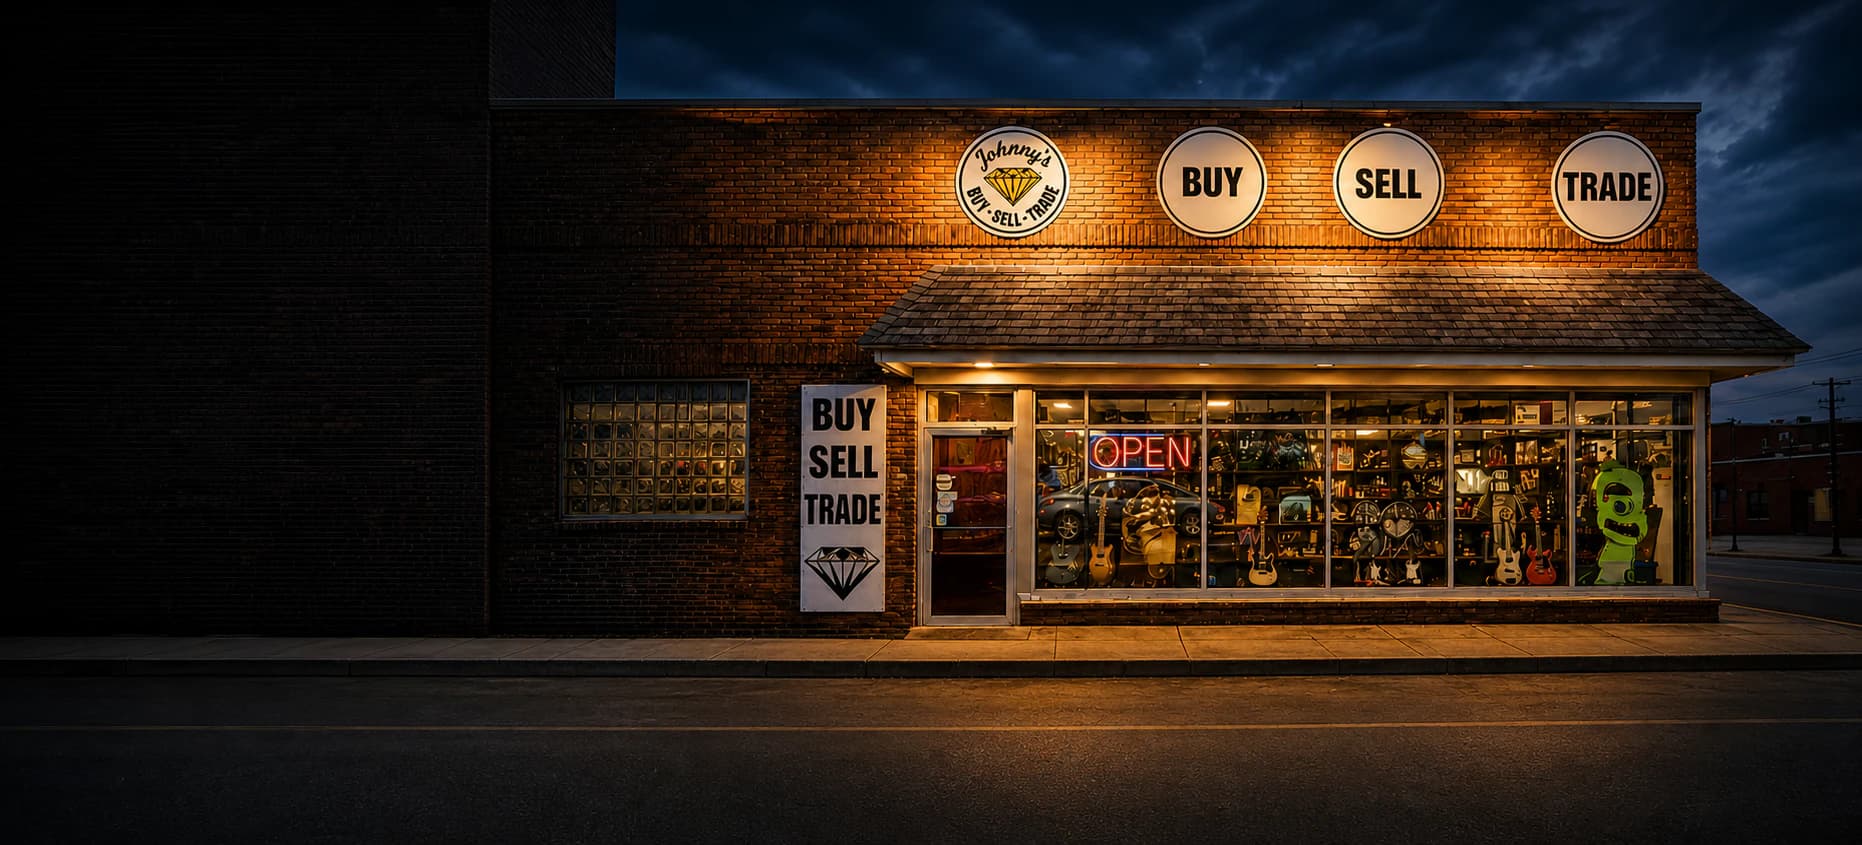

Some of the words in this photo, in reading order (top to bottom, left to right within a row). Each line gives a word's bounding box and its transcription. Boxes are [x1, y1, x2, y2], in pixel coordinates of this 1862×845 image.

[975, 140, 1051, 172] Johnny's
[1182, 167, 1244, 197] BUY
[1355, 168, 1422, 199] SELL
[1563, 172, 1653, 202] TRADE
[967, 186, 991, 213] BUY
[992, 209, 1022, 227] SELL
[1025, 185, 1060, 221] TRADE
[812, 398, 876, 432] BUY
[809, 445, 879, 479] SELL
[1094, 436, 1190, 468] OPEN
[804, 493, 882, 525] TRADE
